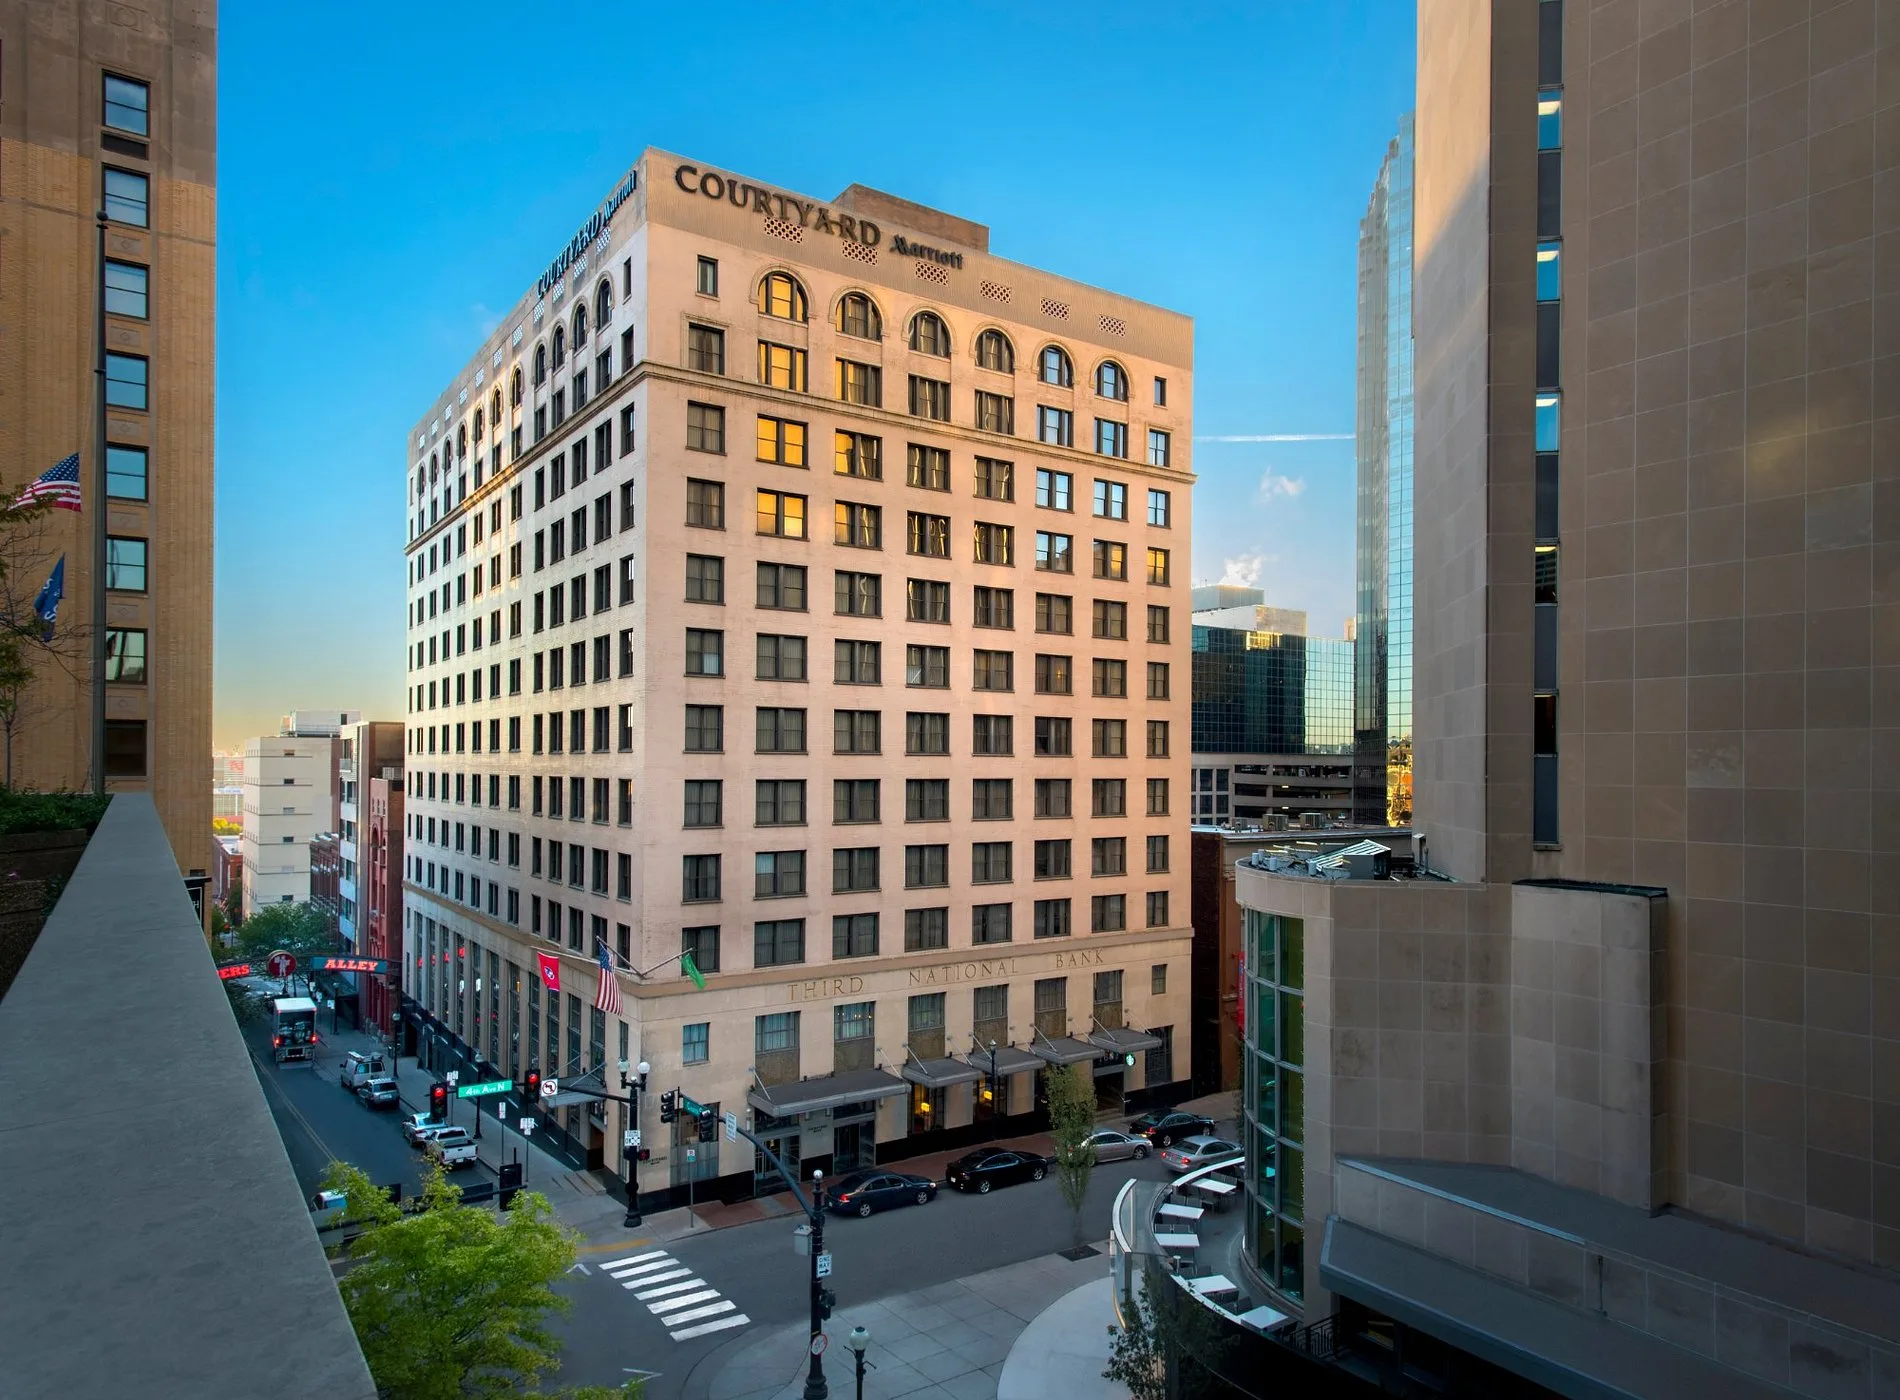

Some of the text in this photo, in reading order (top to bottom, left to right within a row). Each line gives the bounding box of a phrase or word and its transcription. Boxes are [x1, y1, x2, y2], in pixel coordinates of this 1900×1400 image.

[675, 165, 964, 270] COURTYARD Marriott
[537, 211, 602, 301] COURTYARD
[216, 957, 379, 979] ERS ALLEY
[787, 949, 1105, 1001] THIRD NATIONAL BANK
[466, 1082, 505, 1096] 4th Ave N
